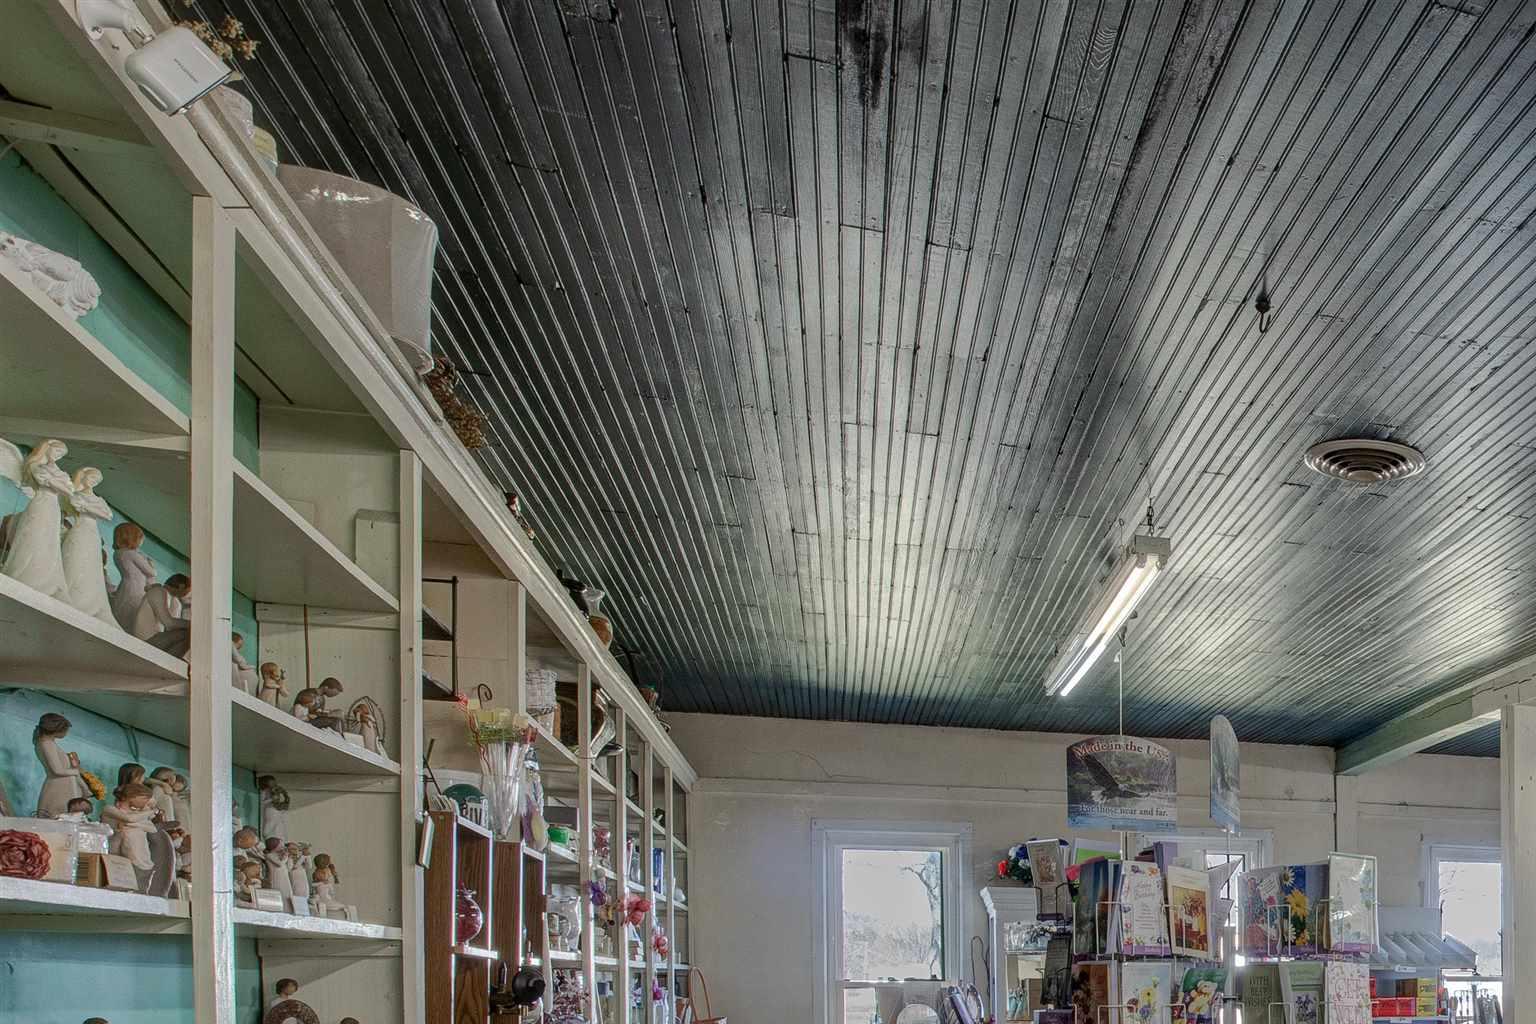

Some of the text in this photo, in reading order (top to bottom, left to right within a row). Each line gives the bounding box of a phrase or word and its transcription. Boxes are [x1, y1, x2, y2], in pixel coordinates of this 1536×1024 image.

[1109, 741, 1121, 750] in
[1126, 741, 1143, 752] the
[1139, 807, 1153, 816] and
